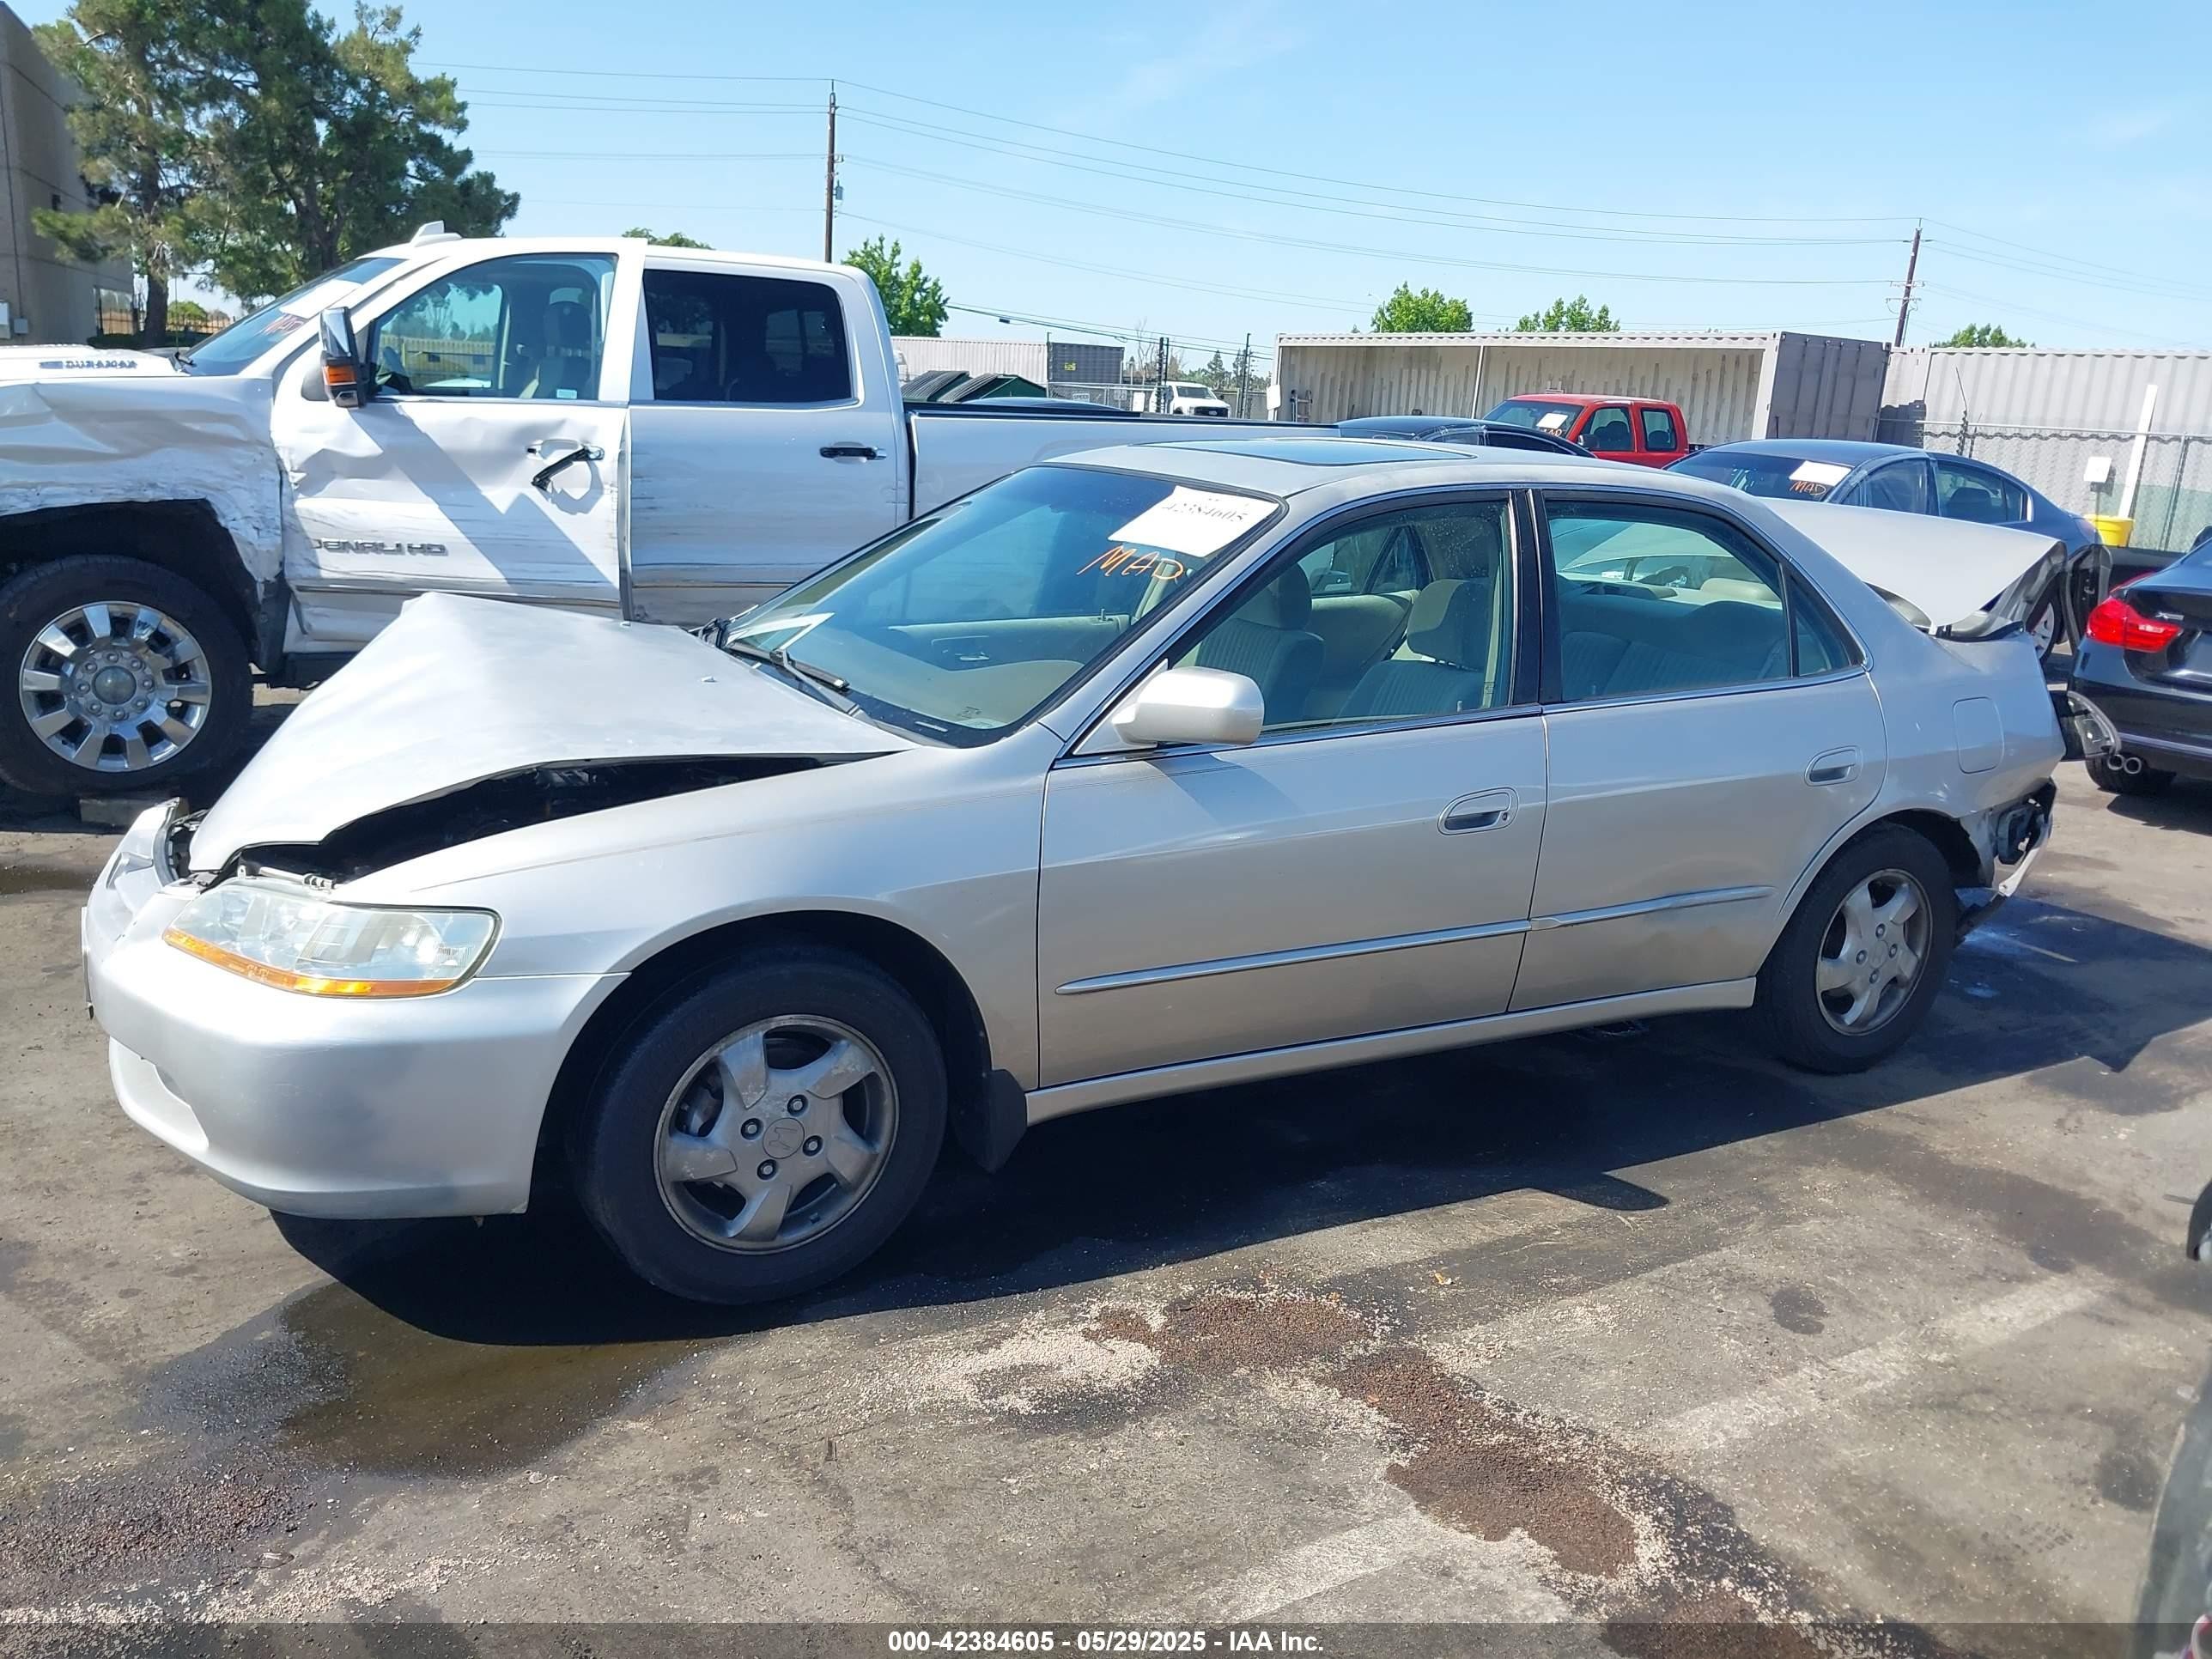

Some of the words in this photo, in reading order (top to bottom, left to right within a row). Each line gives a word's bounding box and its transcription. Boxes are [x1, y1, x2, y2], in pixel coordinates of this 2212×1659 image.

[1790, 481, 1826, 495] MAD
[311, 538, 405, 556] DENALI
[407, 543, 449, 556] HD
[1076, 545, 1184, 580] MAD
